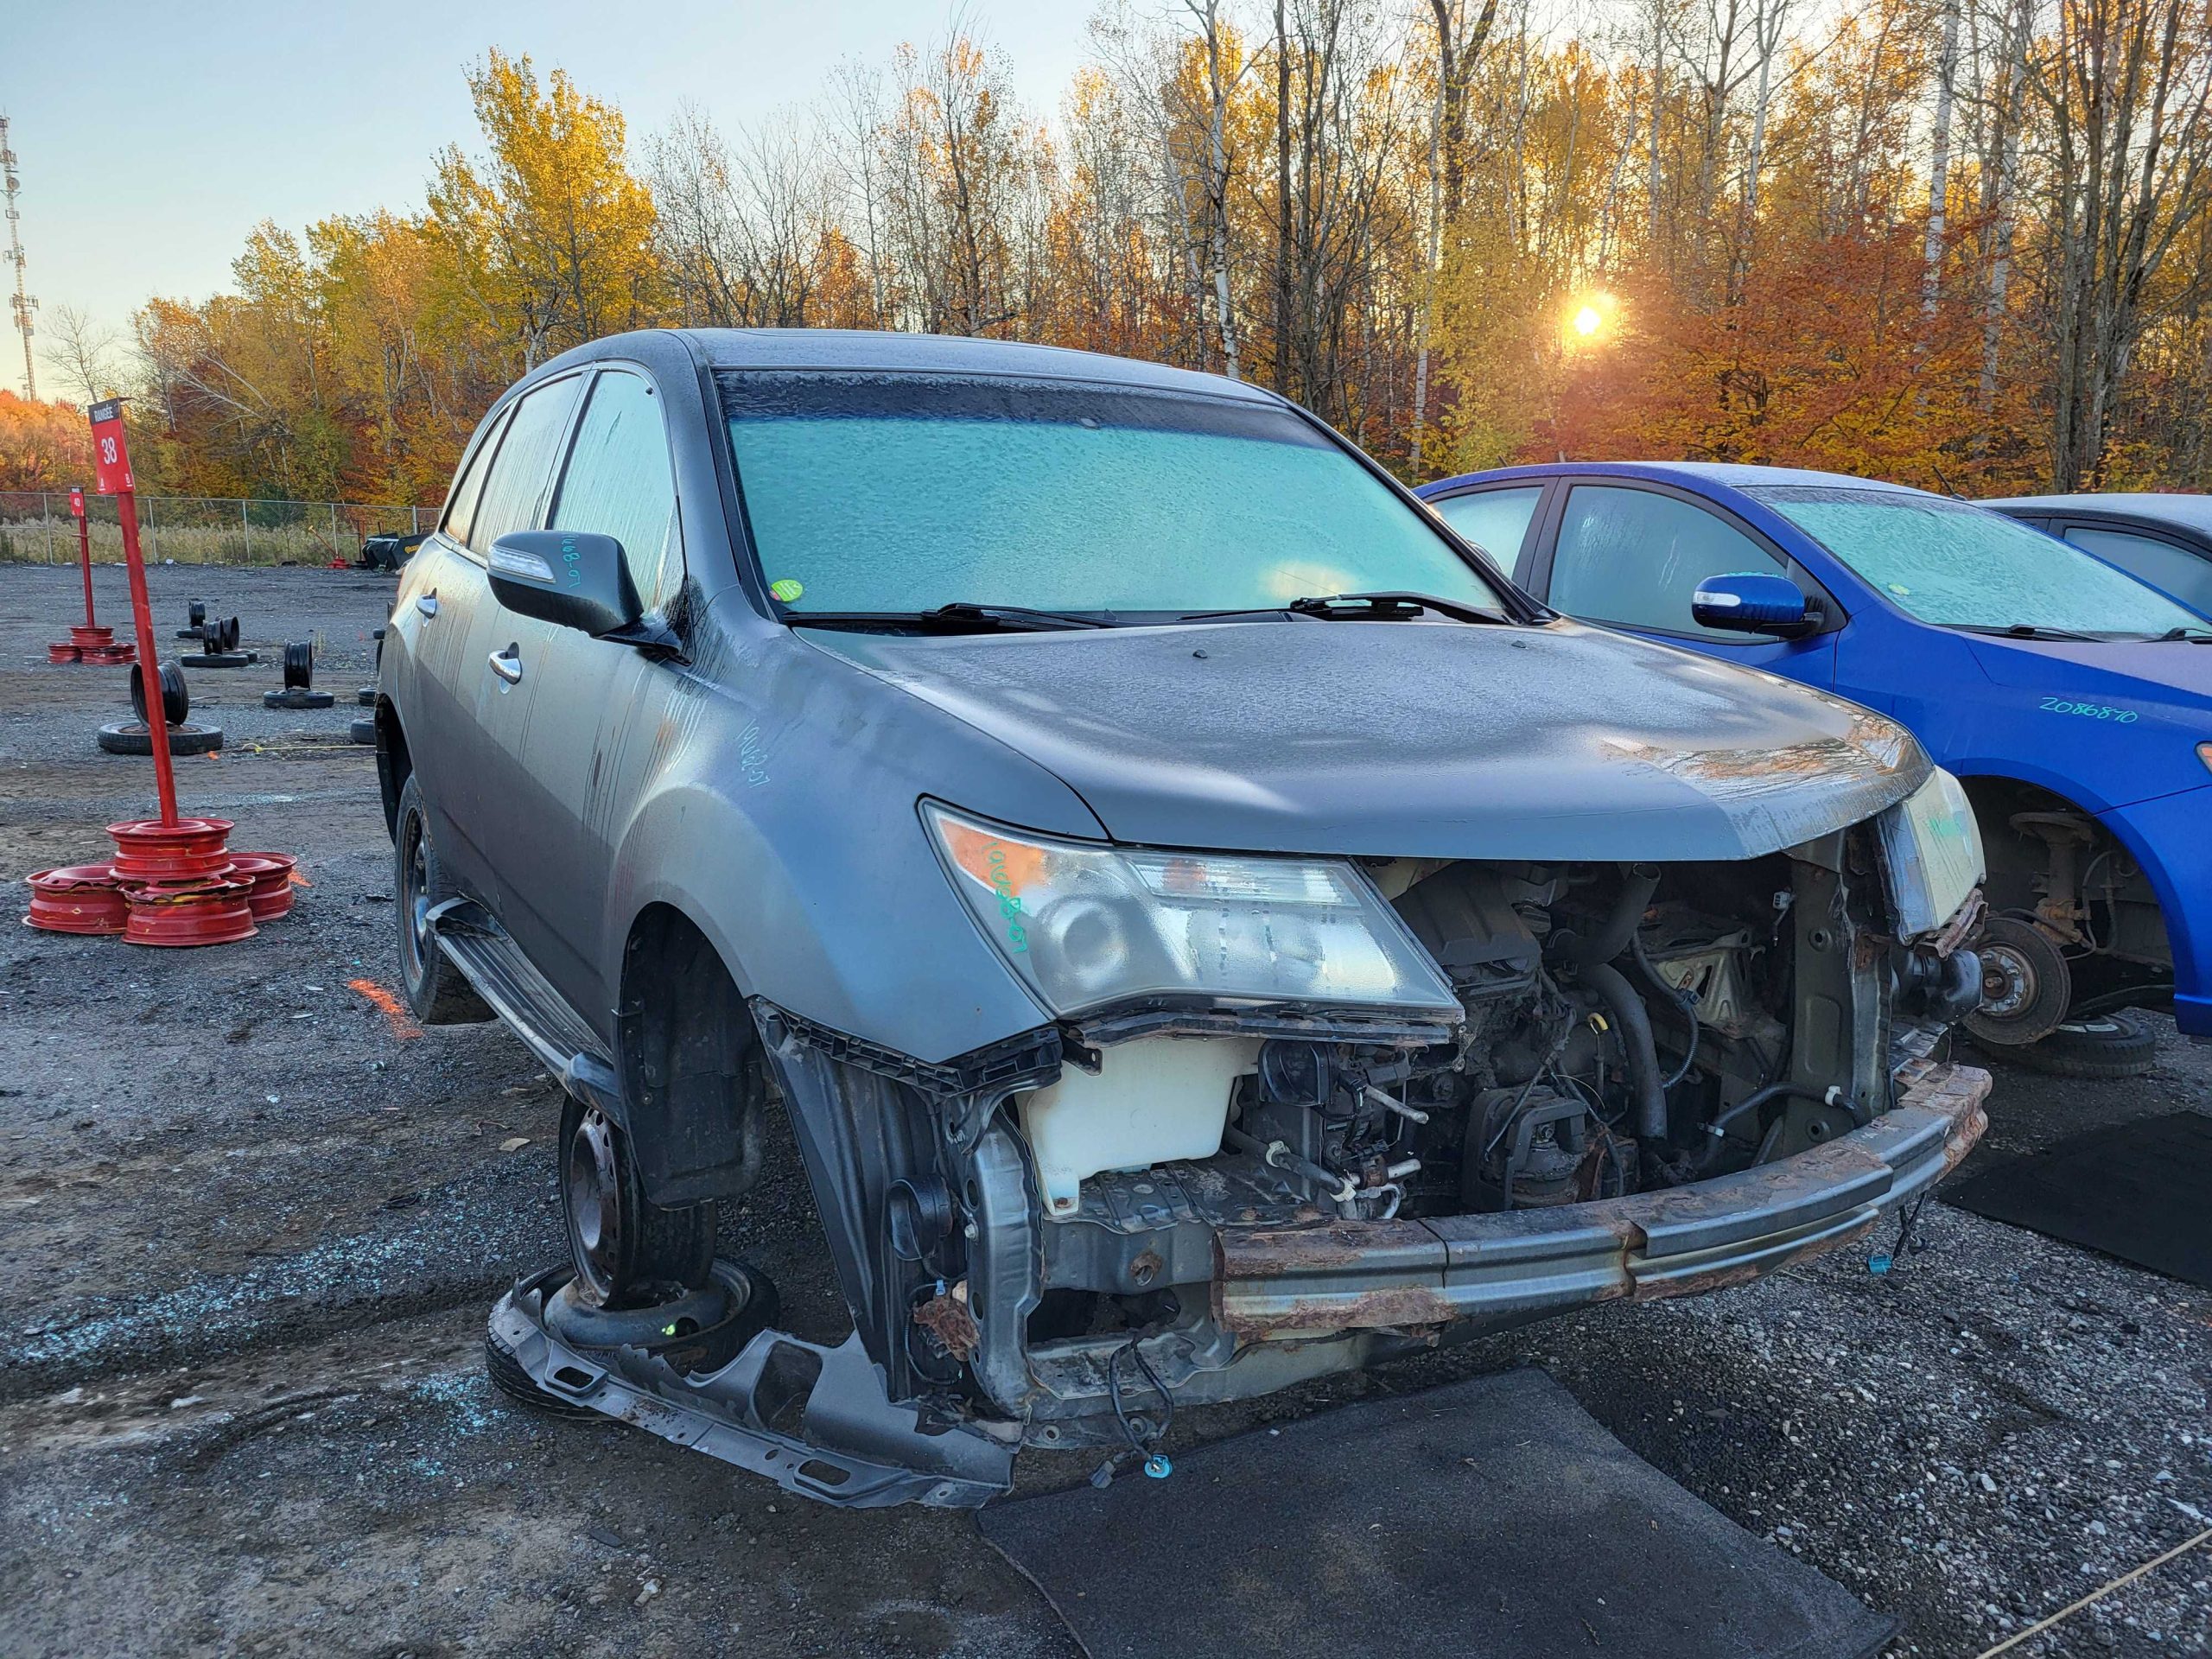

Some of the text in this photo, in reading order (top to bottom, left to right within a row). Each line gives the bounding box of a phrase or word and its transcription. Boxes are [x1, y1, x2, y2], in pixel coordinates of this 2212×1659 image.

[101, 436, 118, 465] 38
[99, 473, 130, 489] A B
